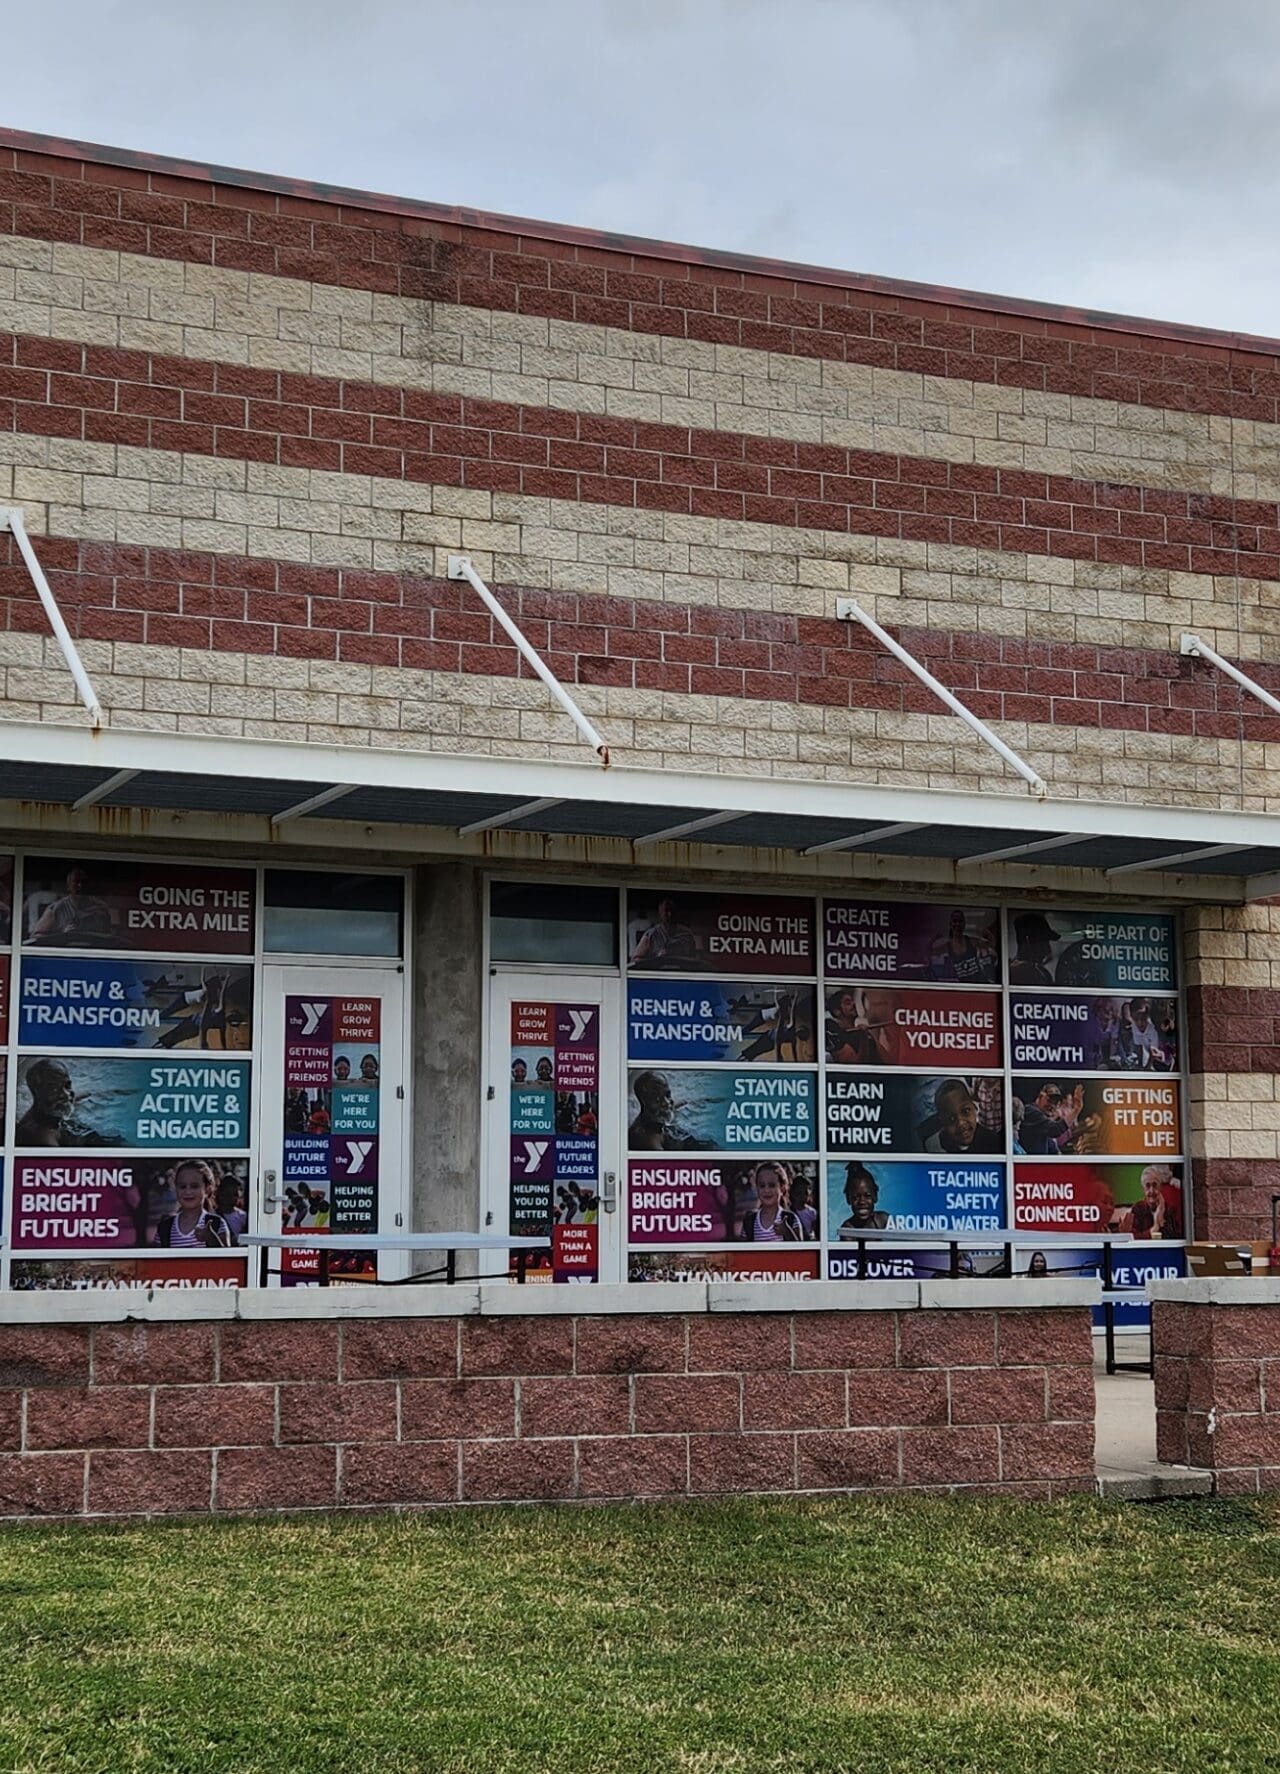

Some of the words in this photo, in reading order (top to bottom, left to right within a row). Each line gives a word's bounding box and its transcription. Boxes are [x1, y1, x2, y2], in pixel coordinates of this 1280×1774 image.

[139, 887, 205, 907] GOING
[209, 889, 250, 908] THE
[127, 910, 197, 930] EXTRA
[202, 913, 249, 932] MILE
[718, 915, 772, 933] GOING
[775, 917, 809, 934] THE
[826, 908, 890, 927] CREATE
[827, 930, 899, 950] LASTING
[1086, 923, 1104, 940] BE
[1108, 925, 1146, 941] PART
[1149, 926, 1169, 942] OF
[709, 937, 767, 954] EXTRA
[770, 939, 809, 956] MILE
[1082, 944, 1169, 962] SOMETHING
[826, 952, 897, 972] CHANGE
[1117, 965, 1170, 982] BIGGER
[23, 978, 105, 999] RENEW
[108, 981, 126, 1000] &
[342, 1003, 372, 1012] LEARN
[519, 1007, 547, 1016] LEARN
[631, 999, 695, 1017] RENEW
[699, 1000, 713, 1017] &
[1013, 1003, 1088, 1021] CREATING
[22, 1005, 161, 1028] TRANSFORM
[289, 1017, 302, 1025] the
[342, 1015, 371, 1024] GROW
[519, 1020, 546, 1028] GROW
[895, 1008, 994, 1028] CHALLENGE
[339, 1028, 374, 1037] THRIVE
[516, 1032, 549, 1040] THRIVE
[558, 1024, 571, 1032] the
[630, 1023, 743, 1042] TRANSFORM
[1014, 1025, 1050, 1041] NEW
[906, 1031, 994, 1050] YOURSELF
[288, 1047, 329, 1056] GETTING
[558, 1052, 595, 1061] GETTING
[1015, 1046, 1084, 1063] GROWTH
[288, 1060, 302, 1069] FIT
[304, 1060, 329, 1069] WITH
[558, 1065, 571, 1073] FIT
[572, 1065, 595, 1073] WITH
[149, 1068, 241, 1088] STAYING
[288, 1073, 328, 1082] FRIENDS
[558, 1077, 594, 1086] FRIENDS
[734, 1078, 809, 1097] STAYING
[827, 1083, 884, 1100] LEARN
[140, 1094, 219, 1113] ACTIVE
[224, 1095, 241, 1114] &
[341, 1094, 370, 1103] WE'RE
[519, 1095, 546, 1104] WE'RE
[1102, 1088, 1173, 1105] GETTING
[343, 1107, 368, 1115] HERE
[521, 1108, 544, 1116] HERE
[727, 1102, 792, 1120] ACTIVE
[795, 1102, 810, 1120] &
[828, 1104, 881, 1122] GROW
[1114, 1109, 1139, 1126] FIT
[1142, 1109, 1174, 1126] FOR
[136, 1119, 240, 1139] ENGAGED
[335, 1120, 354, 1128] FOR
[354, 1120, 376, 1128] YOU
[513, 1120, 530, 1129] FOR
[531, 1120, 551, 1129] YOU
[725, 1125, 810, 1143] ENGAGED
[828, 1127, 892, 1145] THRIVE
[1143, 1131, 1175, 1147] LIFE
[285, 1139, 329, 1148] BUILDING
[556, 1140, 596, 1149] BUILDING
[288, 1153, 325, 1162] FUTURE
[335, 1156, 348, 1164] the
[559, 1153, 593, 1162] FUTURE
[22, 1168, 133, 1187] ENSURING
[286, 1166, 327, 1175] LEADERS
[557, 1166, 595, 1174] LEADERS
[631, 1169, 721, 1186] ENSURING
[928, 1170, 999, 1188] TEACHING
[334, 1186, 374, 1195] HELPING
[513, 1185, 550, 1193] HELPING
[1015, 1183, 1074, 1200] STAYING
[21, 1193, 102, 1212] BRIGHT
[336, 1199, 357, 1208] YOU
[358, 1199, 372, 1208] DO
[514, 1197, 534, 1206] YOU
[535, 1197, 548, 1206] DO
[631, 1192, 697, 1209] BRIGHT
[946, 1193, 999, 1210] SAFETY
[336, 1212, 372, 1221] BETTER
[515, 1210, 548, 1219] BETTER
[1016, 1205, 1100, 1222] CONNECTED
[20, 1218, 120, 1238] FUTURES
[631, 1214, 712, 1232] FUTURES
[886, 1215, 948, 1231] AROUND
[952, 1215, 999, 1231] WATER
[563, 1230, 588, 1238] MORE
[559, 1242, 584, 1250] THAN
[585, 1242, 592, 1250] A
[291, 1260, 319, 1268] GAME
[563, 1254, 588, 1263] GAME
[830, 1258, 915, 1277] DISOVER
